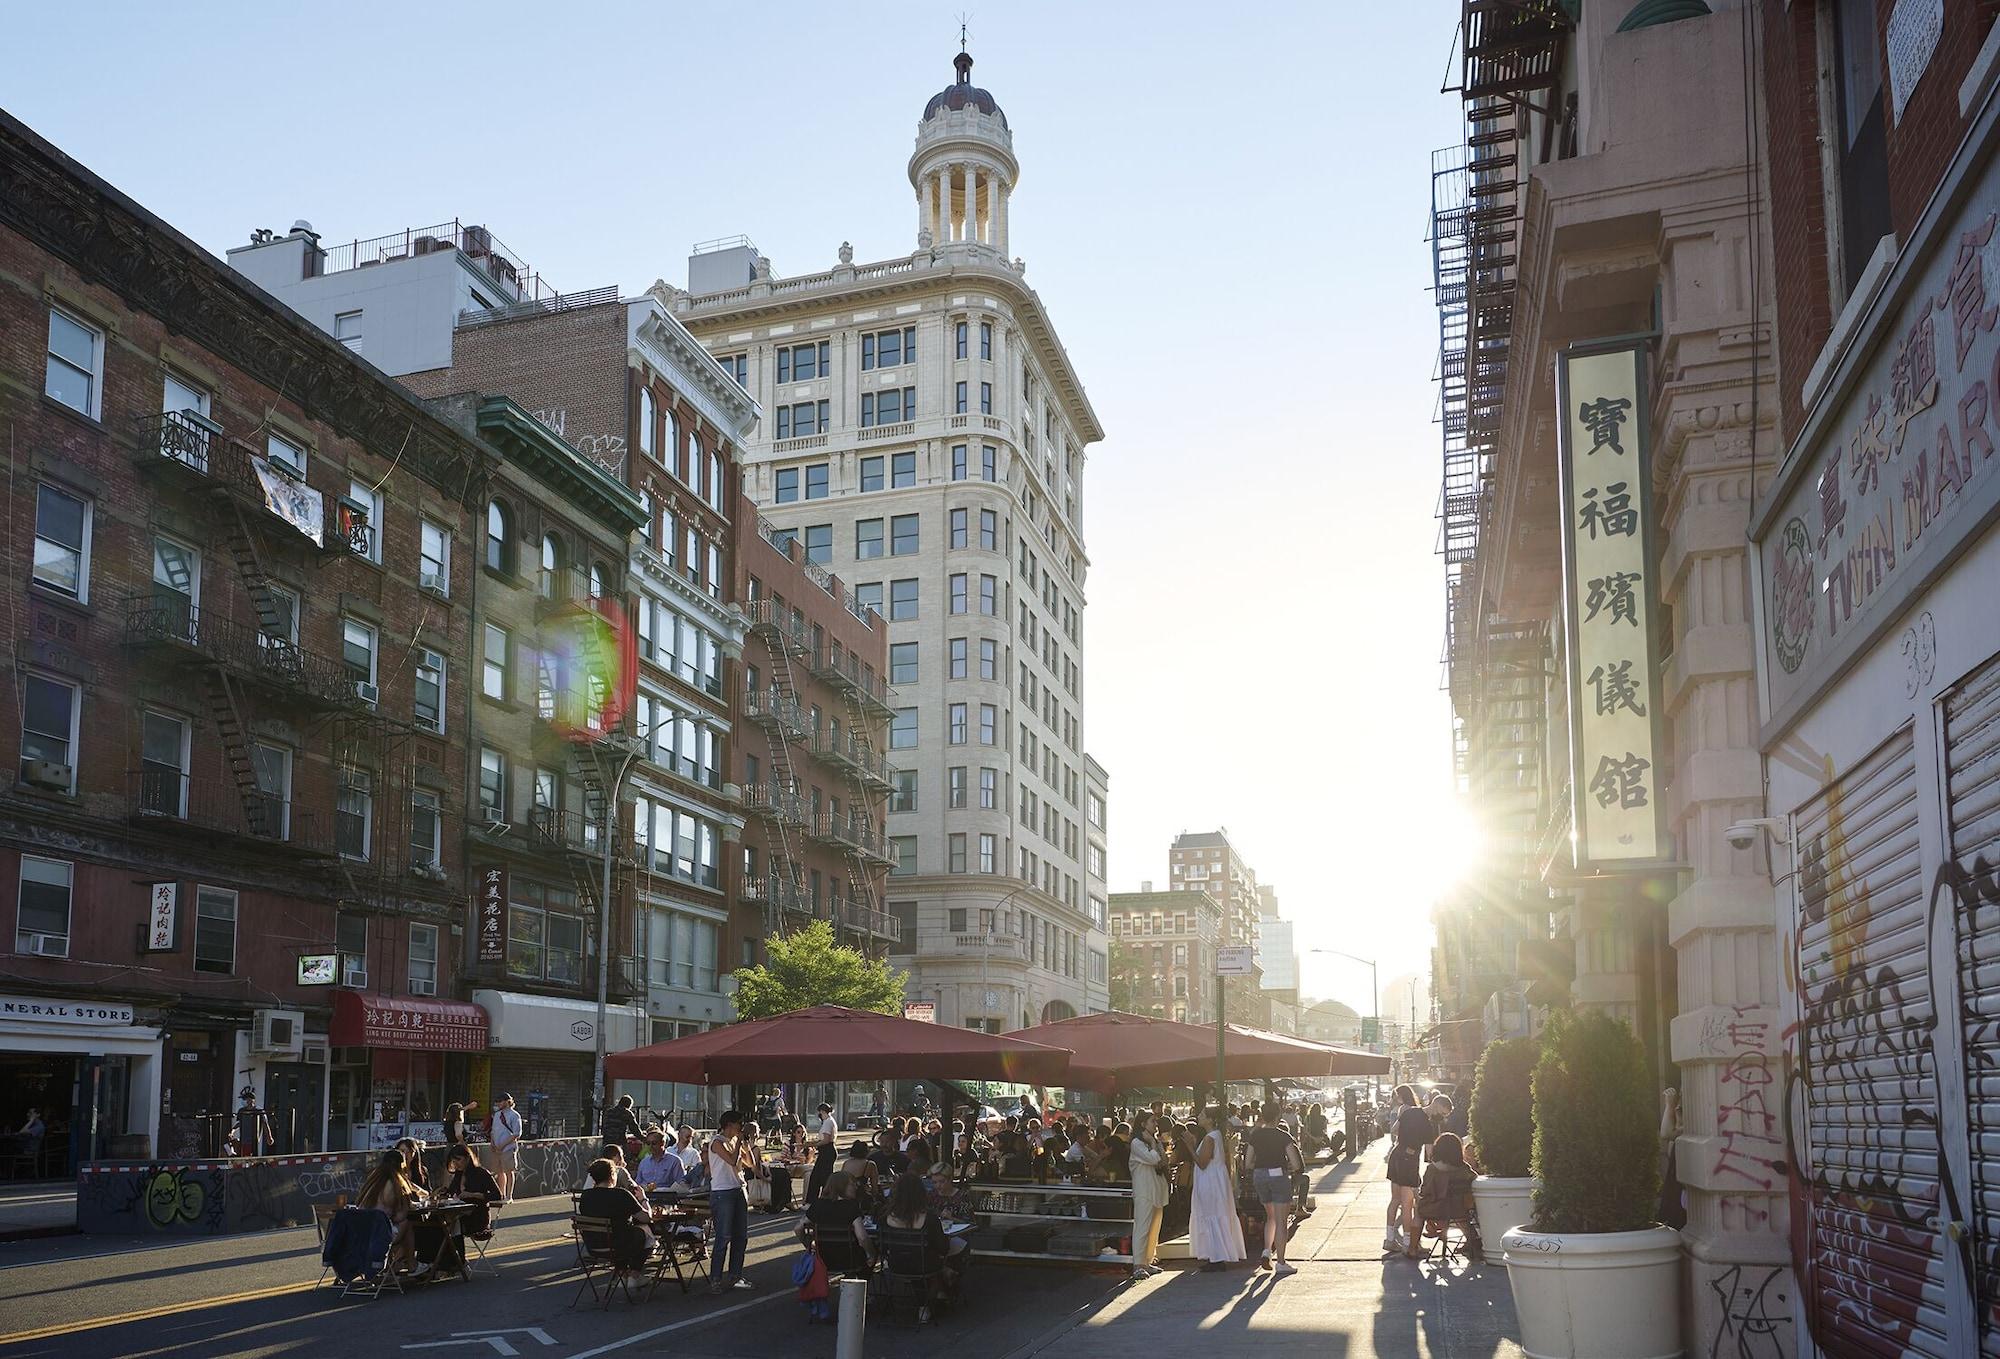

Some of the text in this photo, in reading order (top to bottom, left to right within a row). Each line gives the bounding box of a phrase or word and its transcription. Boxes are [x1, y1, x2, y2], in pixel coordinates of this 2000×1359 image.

[1823, 350, 2000, 637] TWIN MAR
[1578, 397, 1651, 811] 寶福殯儀館
[484, 870, 502, 932] 宏美花店
[1, 1003, 130, 1020] NERAL STORE
[366, 1008, 424, 1028] 玲記肉乾
[408, 1032, 423, 1040] JERKY
[573, 1026, 591, 1035] LABOR
